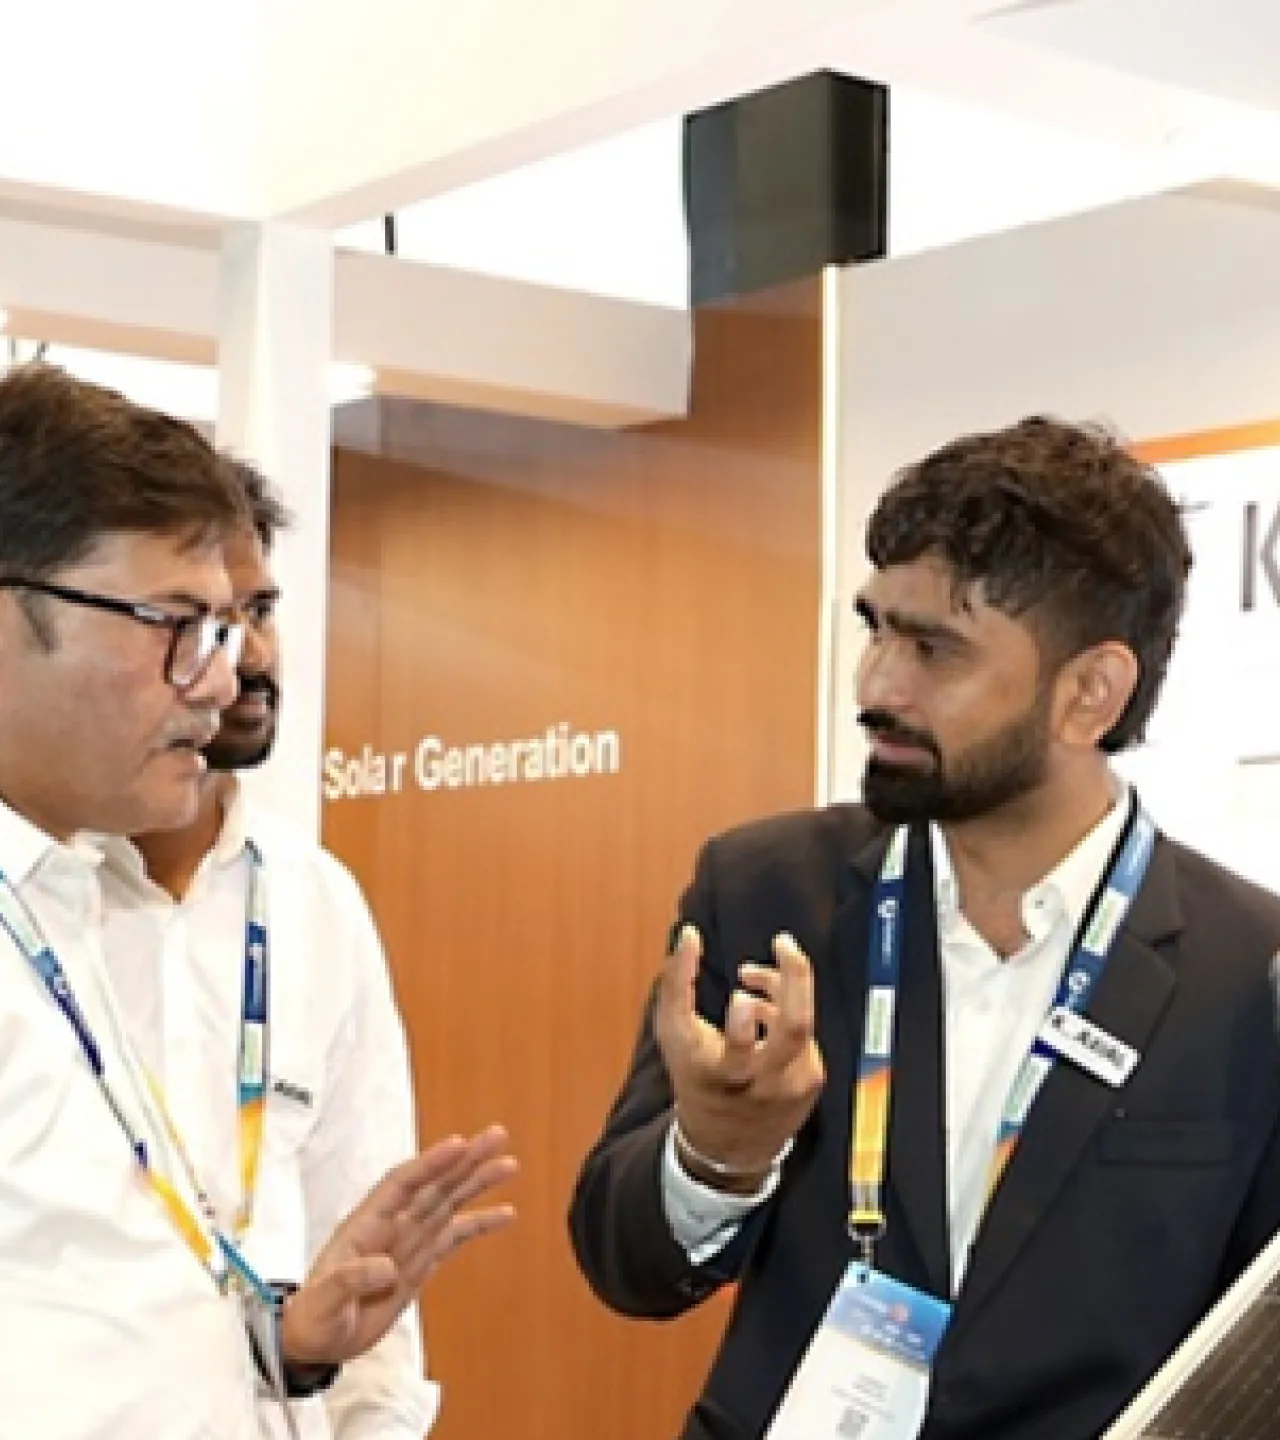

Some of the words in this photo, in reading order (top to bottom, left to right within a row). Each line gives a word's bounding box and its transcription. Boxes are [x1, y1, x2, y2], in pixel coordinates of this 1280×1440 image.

[322, 743, 407, 800] Solar
[416, 721, 620, 790] Generation
[1051, 1013, 1126, 1070] KAXIAL
